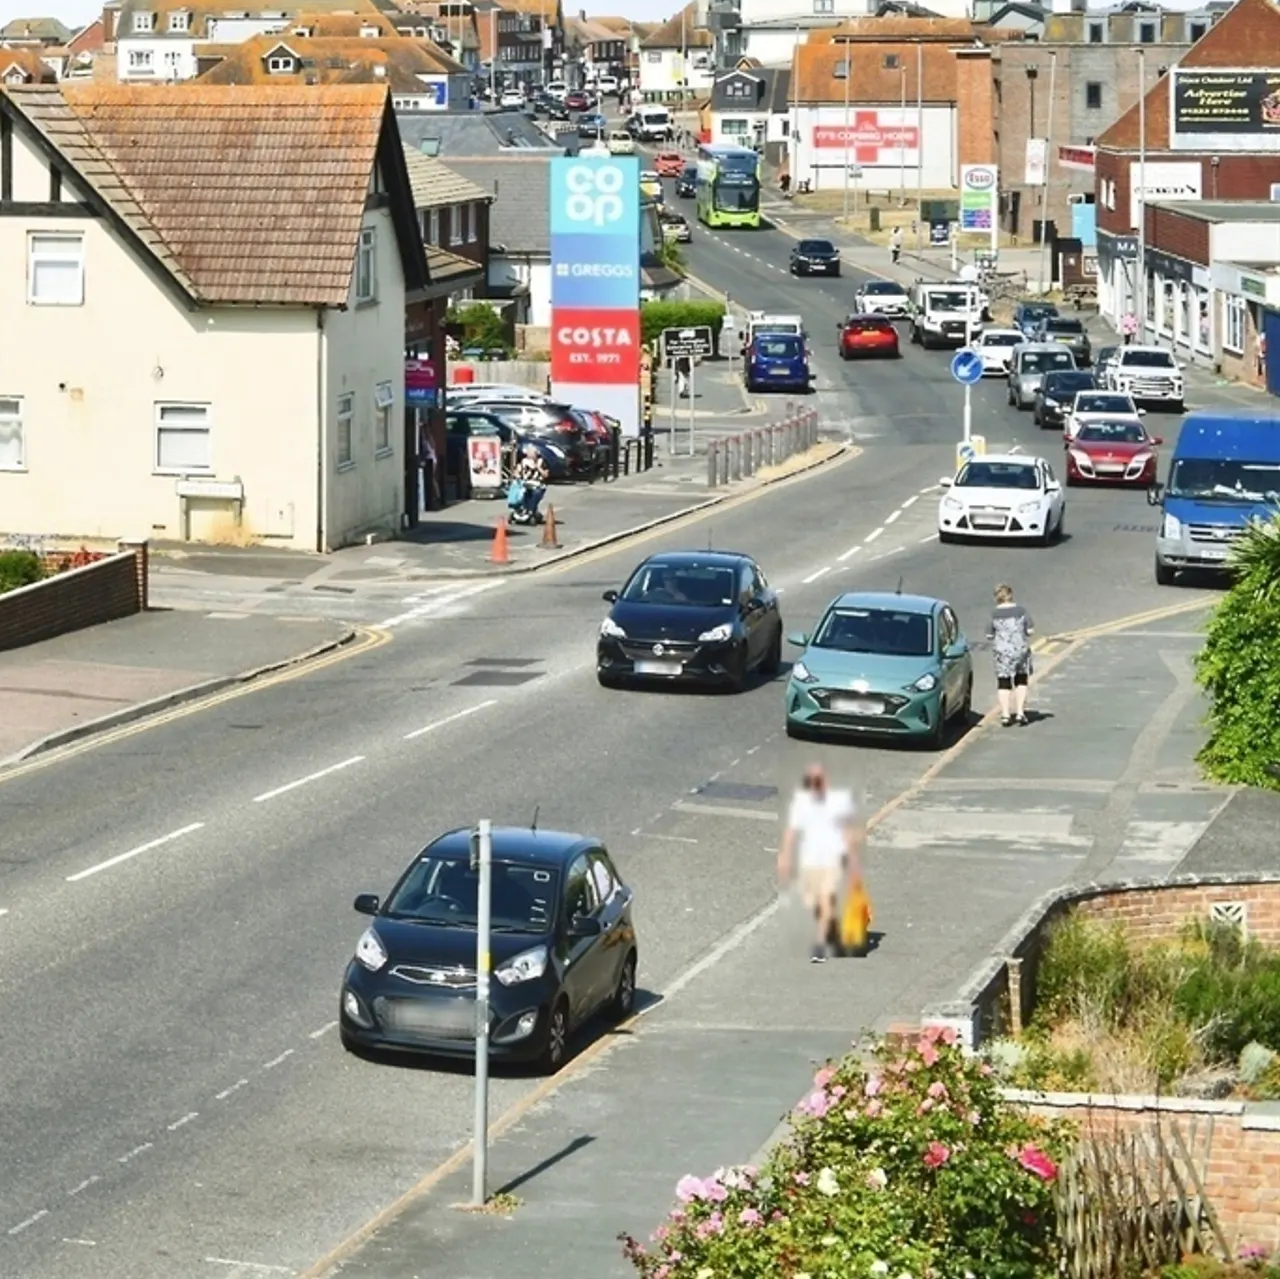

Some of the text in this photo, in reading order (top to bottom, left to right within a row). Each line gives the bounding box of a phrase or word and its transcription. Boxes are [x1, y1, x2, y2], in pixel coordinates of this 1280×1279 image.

[1183, 89, 1247, 97] Advertise
[1199, 97, 1233, 105] Here
[565, 165, 624, 194] CO
[968, 172, 991, 184] Esso
[571, 263, 633, 277] GREGGS
[557, 327, 632, 348] COSTA
[569, 353, 621, 364] EST. 1971
